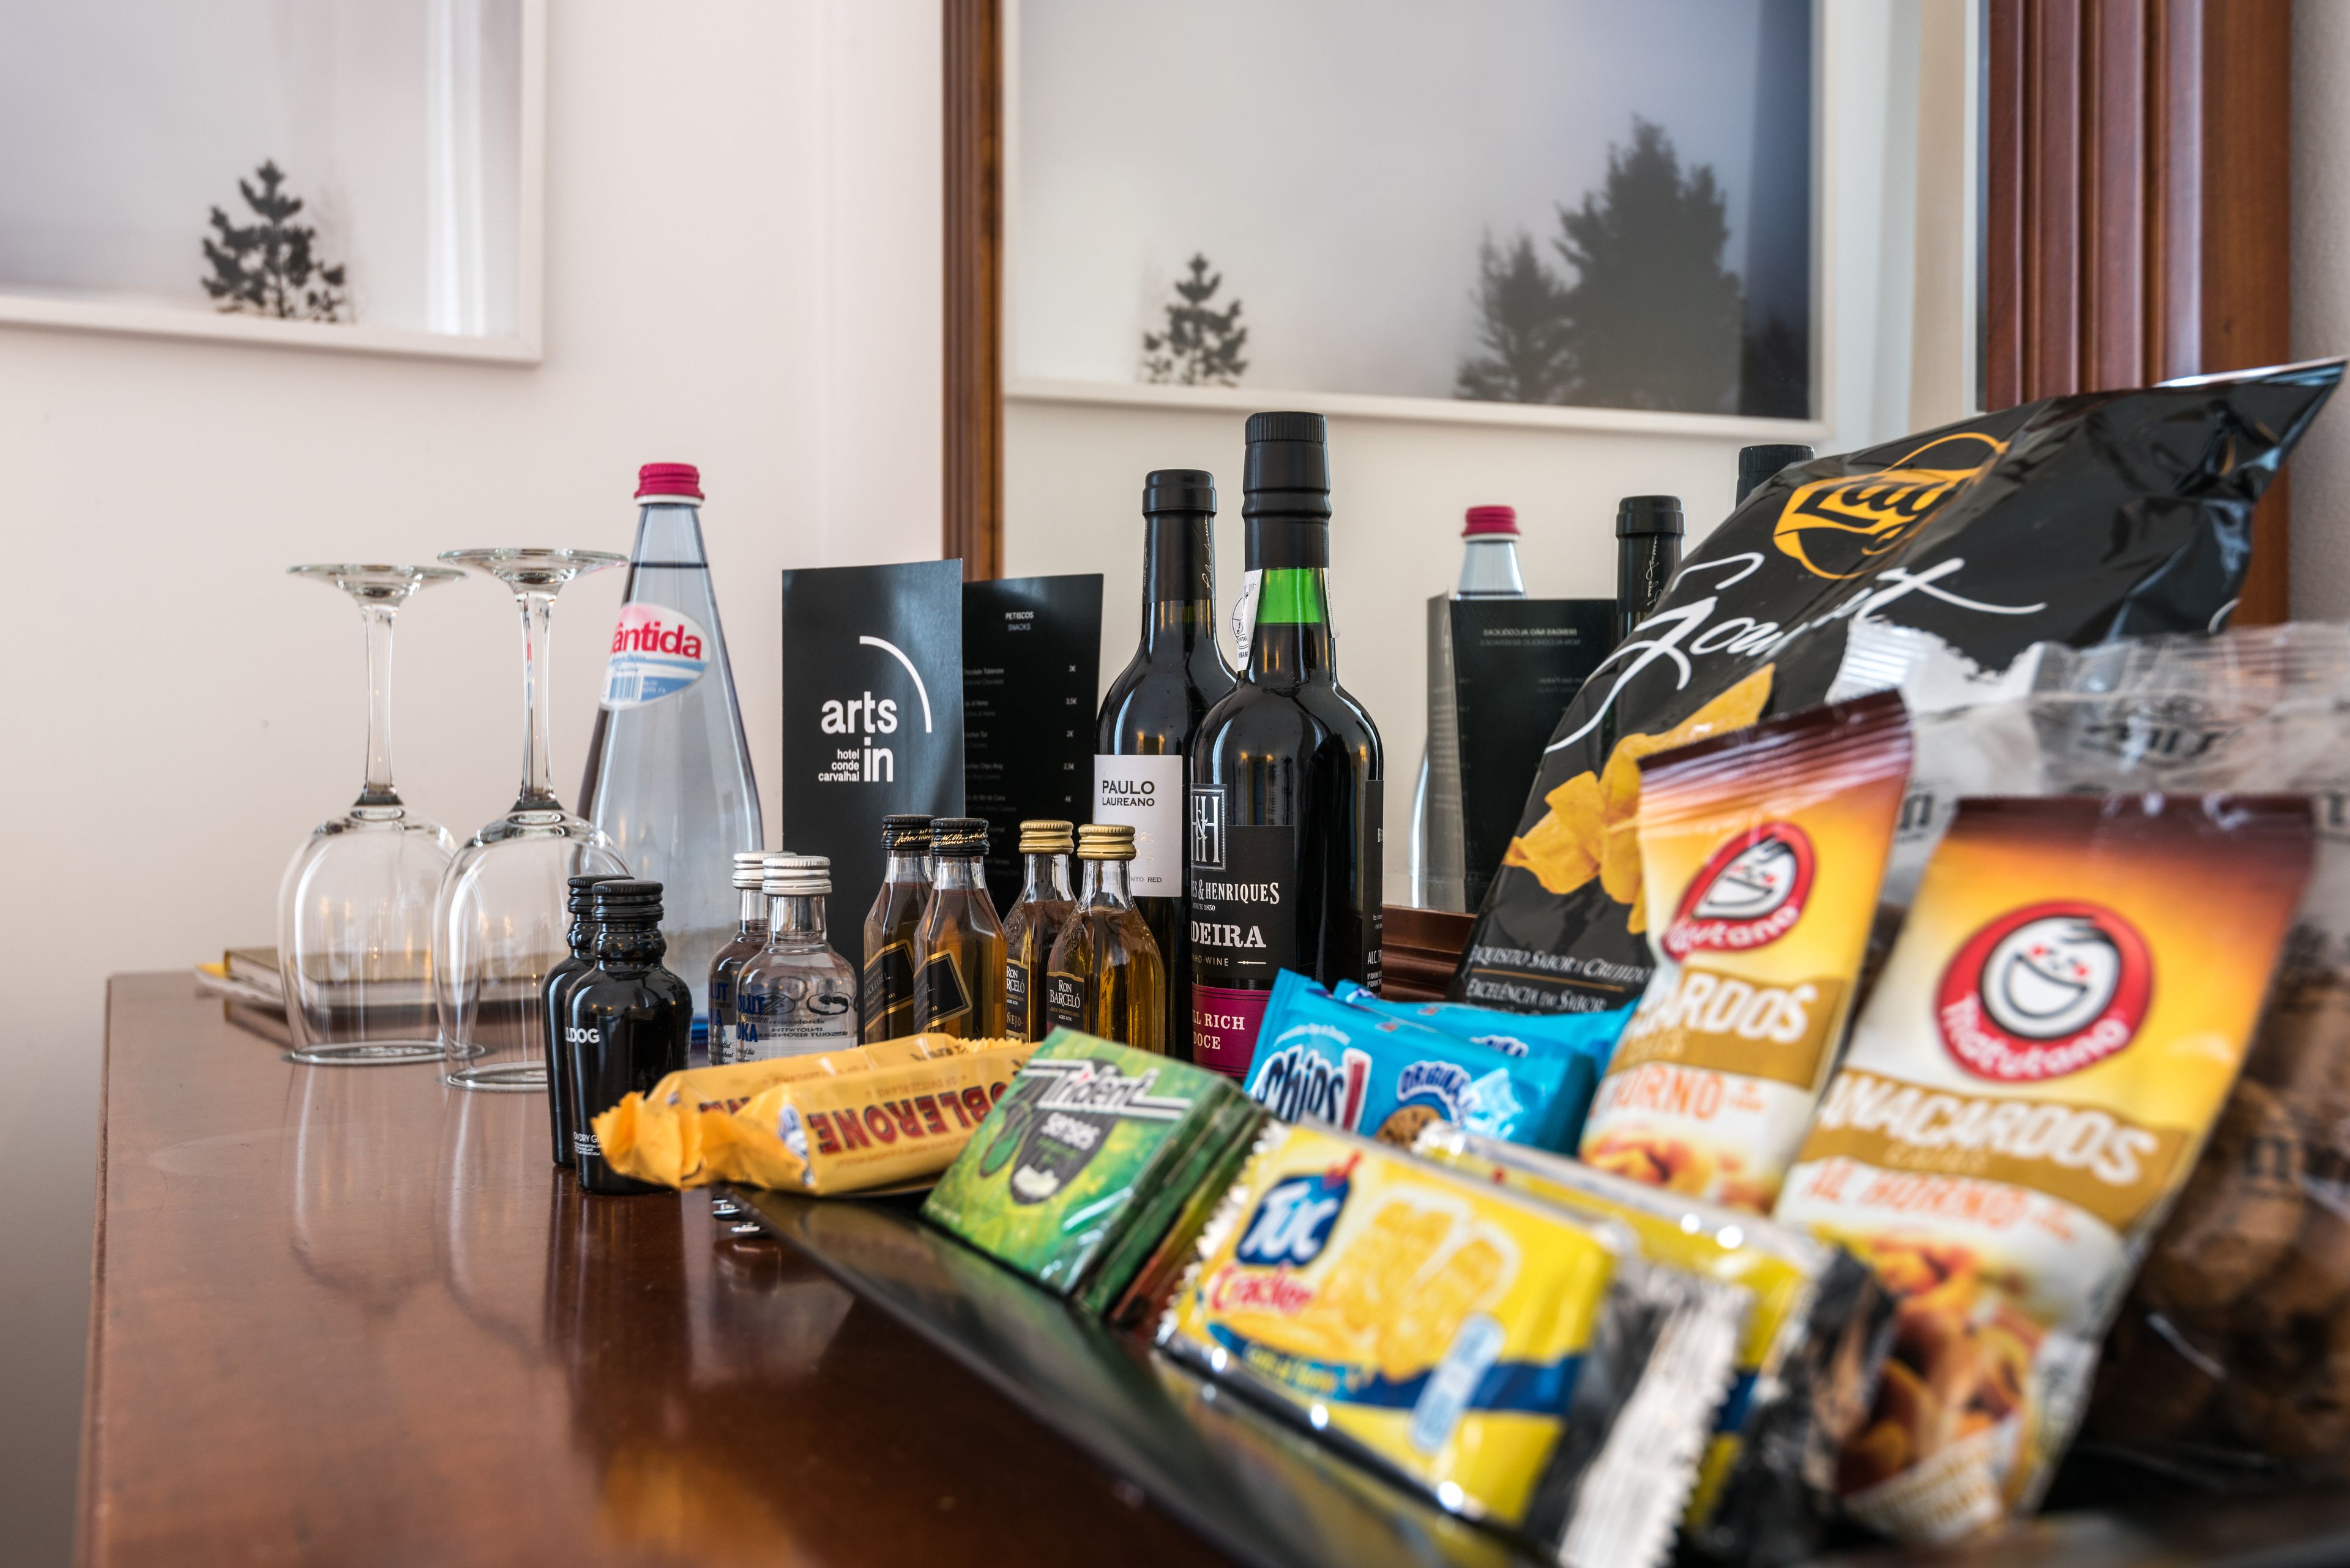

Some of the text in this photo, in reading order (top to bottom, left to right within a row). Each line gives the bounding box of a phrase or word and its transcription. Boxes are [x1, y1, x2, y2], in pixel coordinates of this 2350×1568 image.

[1005, 611, 1034, 621] PETISCOS
[1008, 622, 1031, 632] SNACKS
[821, 691, 898, 734] arts
[837, 749, 859, 760] hotel
[864, 736, 893, 782] in
[831, 760, 859, 771] conde
[818, 771, 859, 782] carvalhal
[1102, 780, 1155, 795] PAULO
[1102, 797, 1155, 807] LAUREANO
[1205, 882, 1280, 905] HENRIQUES
[1205, 958, 1229, 966] WINE
[1058, 979, 1072, 993] RON
[1050, 989, 1080, 1009] BARCELÓ
[1204, 1013, 1245, 1030] RICH
[1193, 1031, 1220, 1050] DOCE
